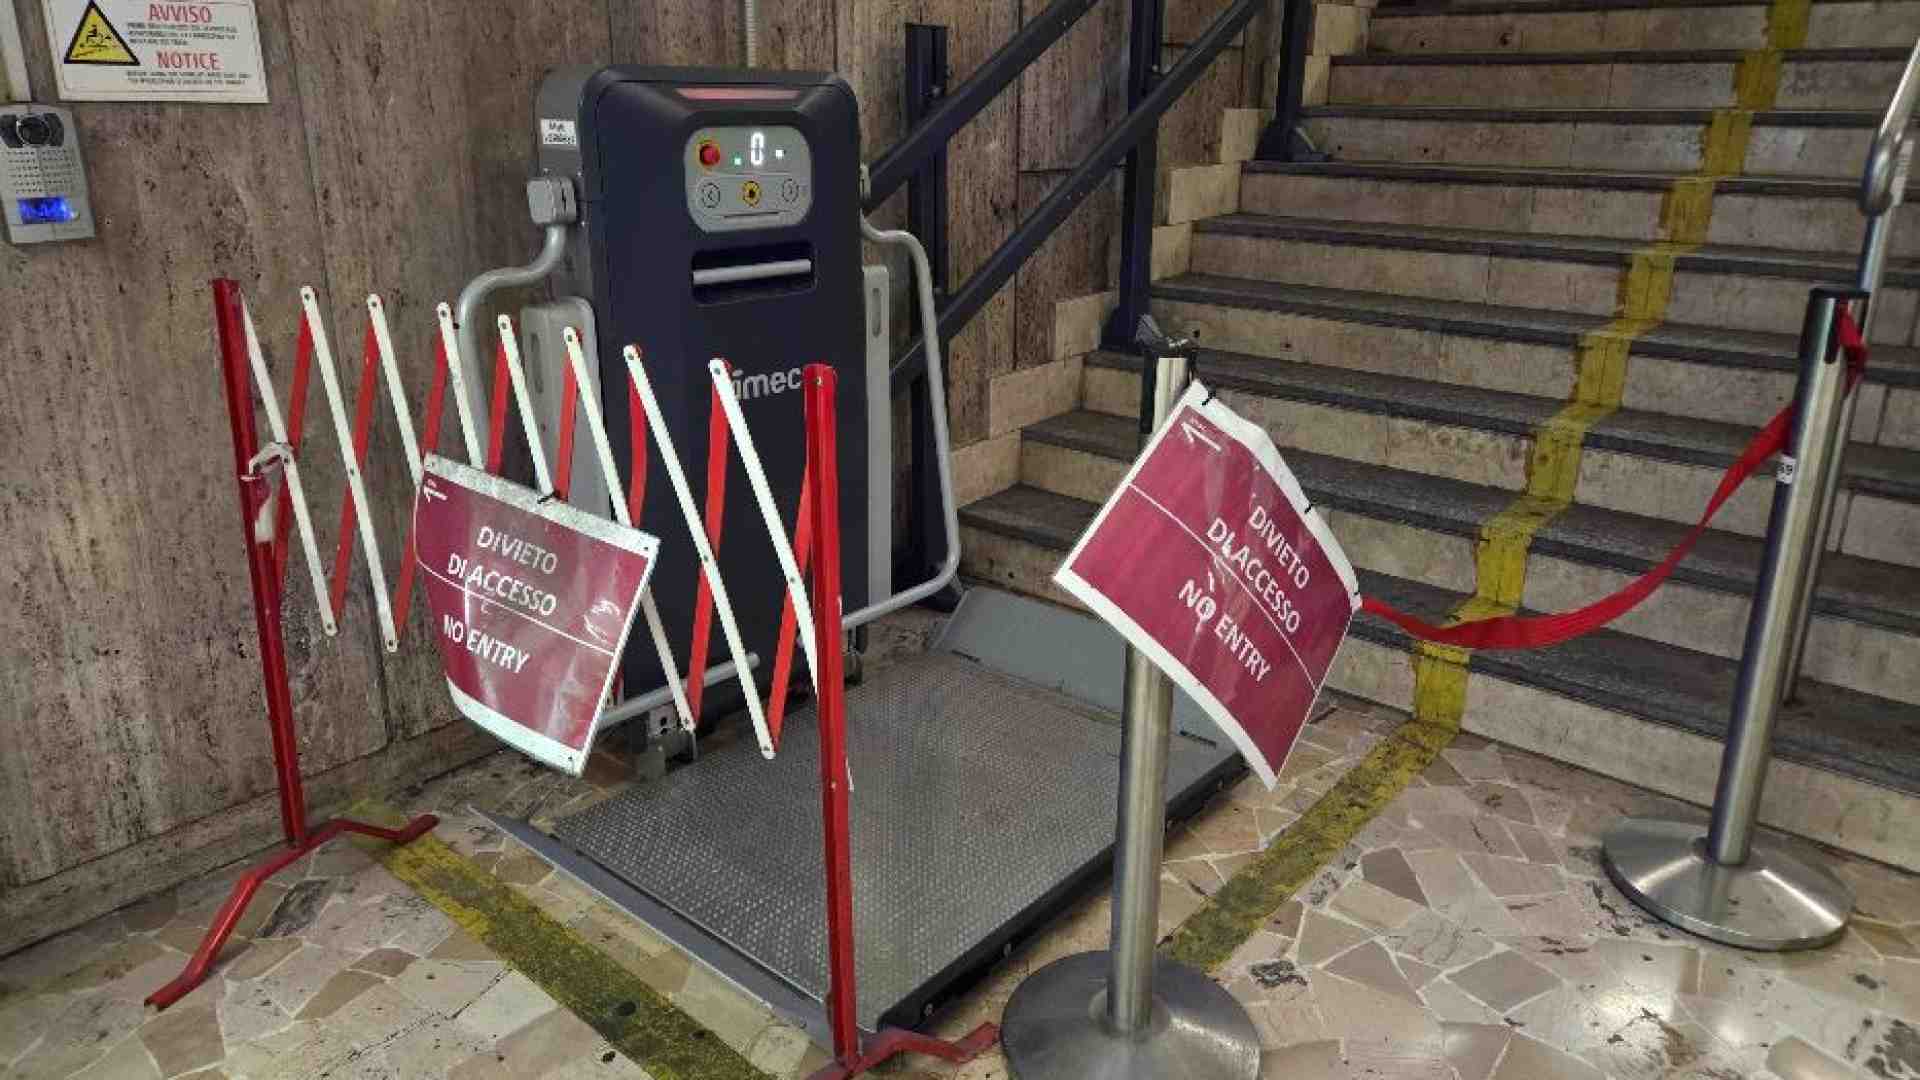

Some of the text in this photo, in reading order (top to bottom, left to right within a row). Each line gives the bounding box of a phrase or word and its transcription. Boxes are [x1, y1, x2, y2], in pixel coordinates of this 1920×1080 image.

[149, 4, 211, 23] AVVISO
[157, 53, 220, 69] NOTICE
[732, 367, 802, 400] imec
[477, 526, 557, 574] DIVIETO
[1207, 517, 1300, 633] DI ACCESSO
[1249, 505, 1310, 589] DIVIETO
[448, 553, 556, 616] DI ACCESSO
[444, 614, 530, 674] NO ENTRY
[1178, 579, 1271, 682] NO ENTRY
